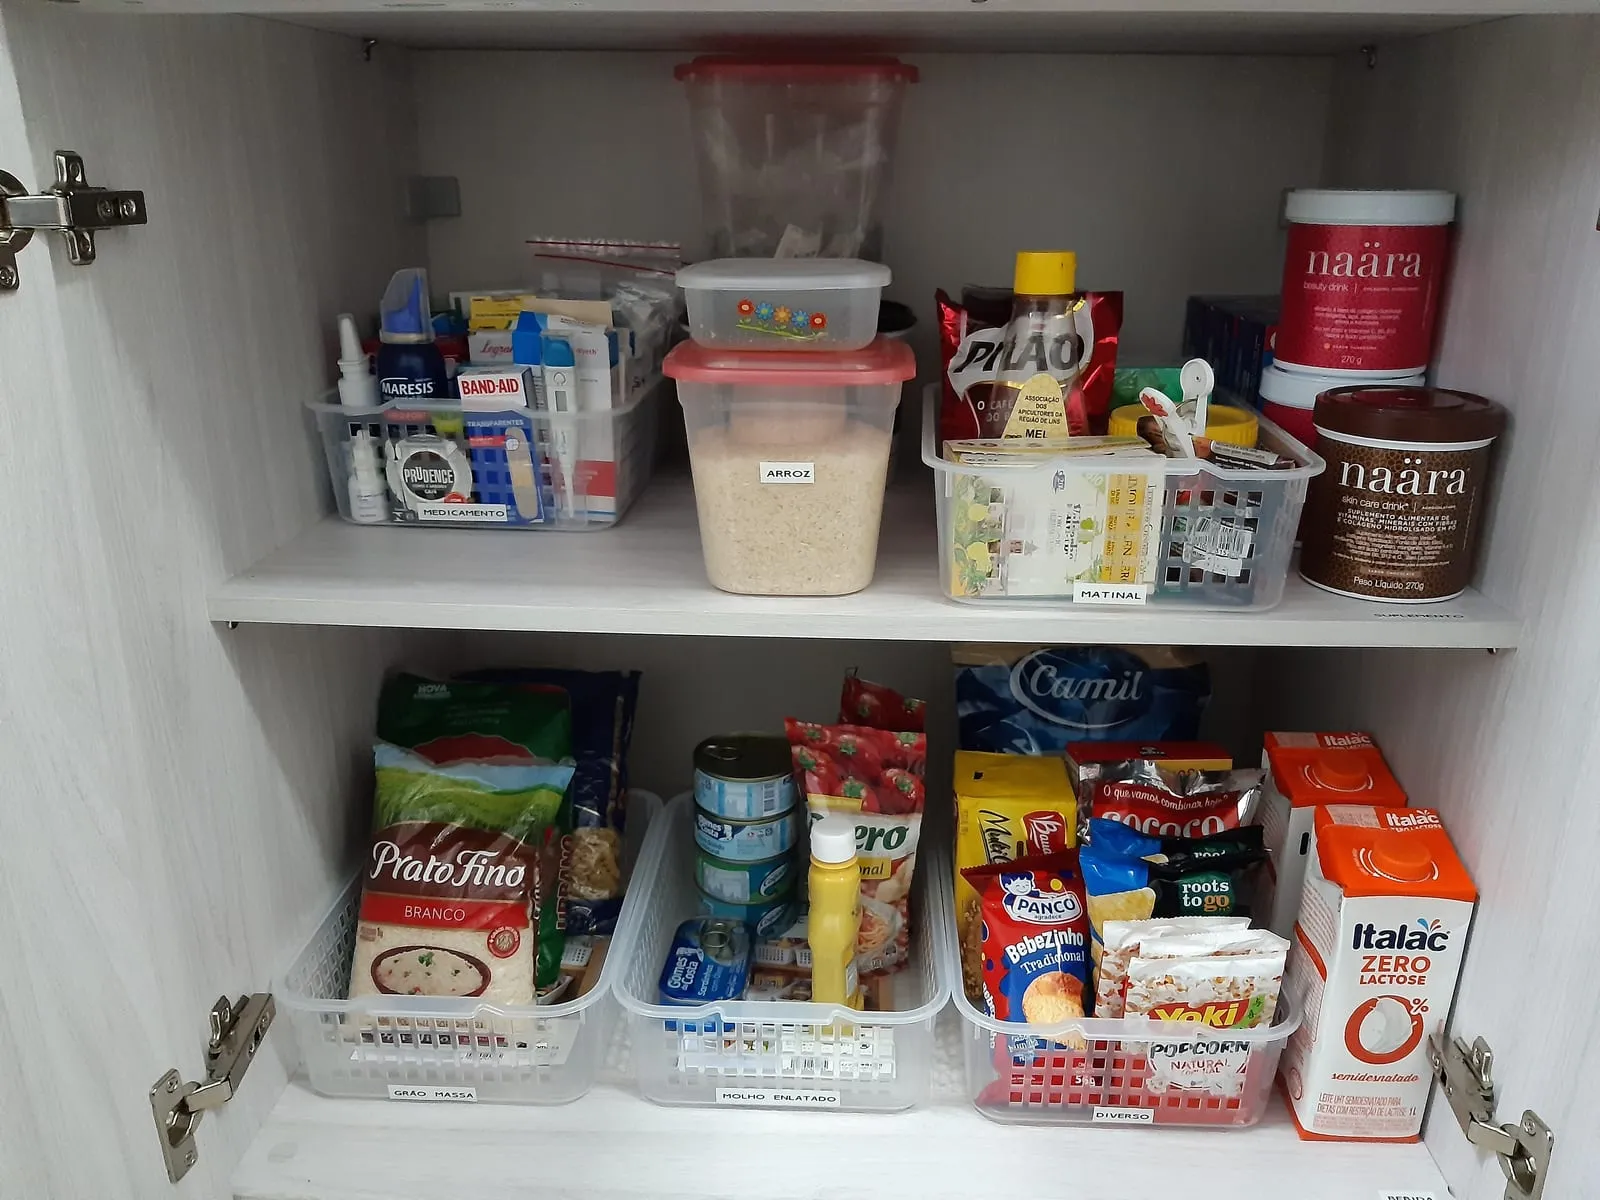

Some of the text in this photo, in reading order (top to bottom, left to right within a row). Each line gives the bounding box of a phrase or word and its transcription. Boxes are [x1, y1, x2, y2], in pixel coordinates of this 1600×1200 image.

[1306, 242, 1421, 278] naära
[1328, 283, 1349, 292] drink
[382, 381, 434, 395] MARESIS
[461, 379, 519, 395] BAND-AID
[977, 400, 985, 411] O
[467, 419, 523, 427] TRANSPARENTES
[1025, 429, 1048, 438] MEL
[403, 466, 454, 484] PRUDENCE
[766, 468, 811, 478] ARROZ
[1339, 458, 1465, 496] naära
[1342, 496, 1358, 505] skin
[1360, 499, 1380, 509] care
[423, 509, 505, 517] MEDICAMENTO
[1347, 508, 1396, 520] SUPLEMENTO
[1379, 518, 1415, 527] MINERAIS
[1353, 576, 1425, 591] Peso Líquido 270g
[1081, 590, 1142, 600] MATINAL
[418, 683, 448, 694] NOVA
[1030, 664, 1144, 701] Camil
[1324, 735, 1371, 746] Italac
[1103, 784, 1111, 796] O
[1114, 788, 1131, 801] que
[1131, 790, 1160, 804] vamos
[1160, 798, 1202, 811] combinar
[1386, 811, 1440, 827] Italac
[369, 840, 526, 888] Prato Fino
[1182, 879, 1229, 894] roots
[1017, 894, 1076, 915] PANCO
[1182, 894, 1230, 912] to go
[404, 905, 466, 922] BRANCO
[1353, 922, 1449, 952] Italac
[1020, 950, 1085, 975] Tradicional
[1360, 955, 1432, 974] ZERO
[668, 957, 687, 989] Gomes
[684, 961, 699, 985] Costa
[1359, 975, 1427, 985] LACTOSE
[1150, 1040, 1251, 1059] POPCORN
[1170, 1058, 1231, 1070] NATURAL
[1331, 1072, 1420, 1083] semidesnatado
[434, 1091, 474, 1099] MASSA
[722, 1093, 837, 1103] MOLHO ENLATADO
[1095, 1111, 1150, 1120] DIVERSO
